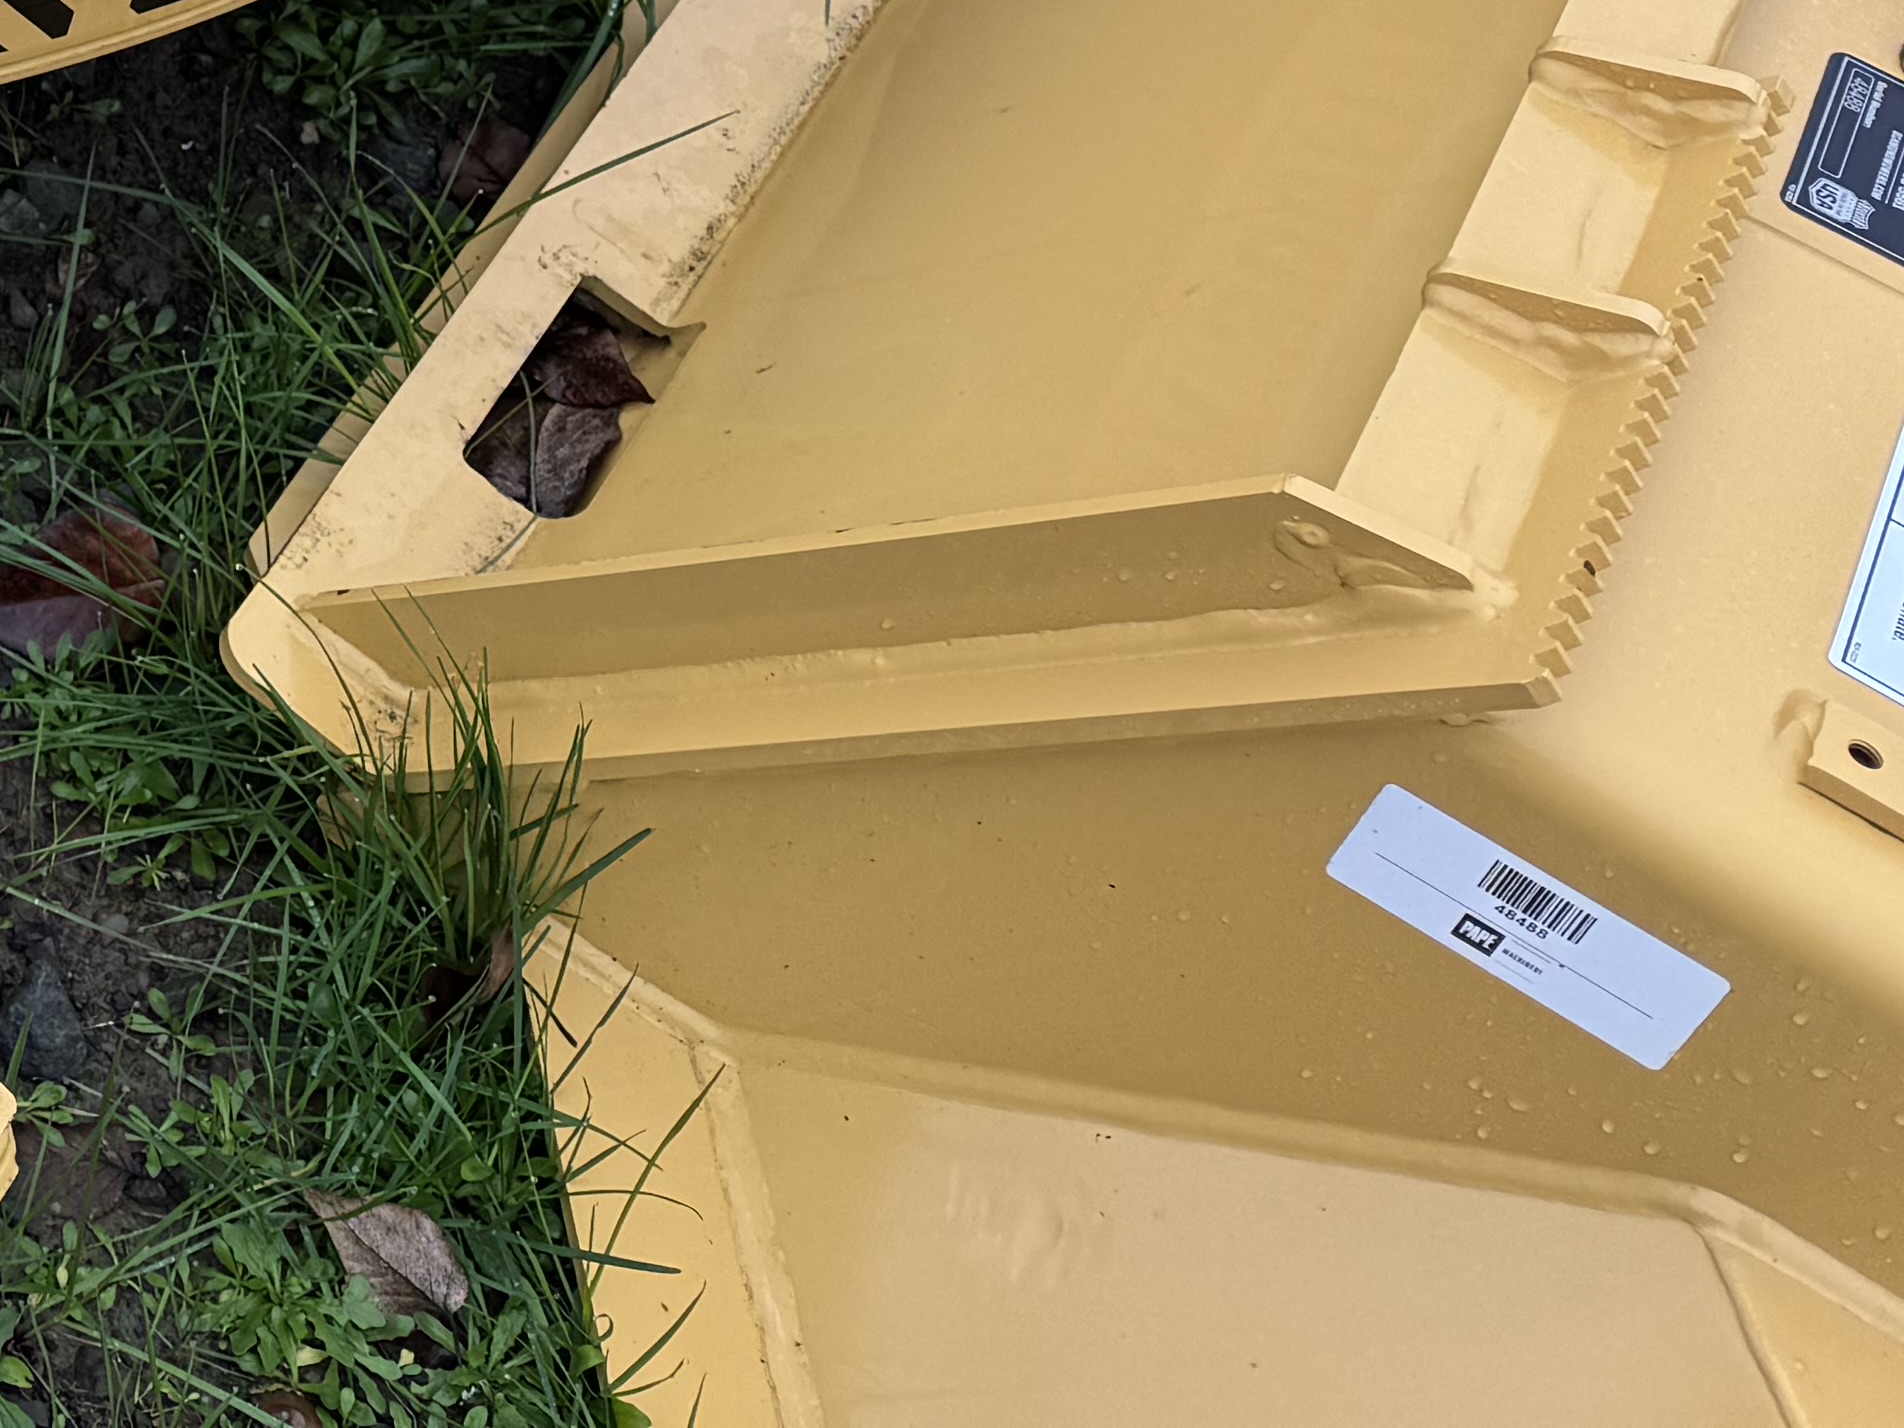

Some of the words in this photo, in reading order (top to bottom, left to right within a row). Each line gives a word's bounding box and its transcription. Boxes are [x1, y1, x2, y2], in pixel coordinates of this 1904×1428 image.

[1843, 77, 1870, 114] 48488
[1814, 182, 1839, 211] USA
[1494, 904, 1549, 940] 48488
